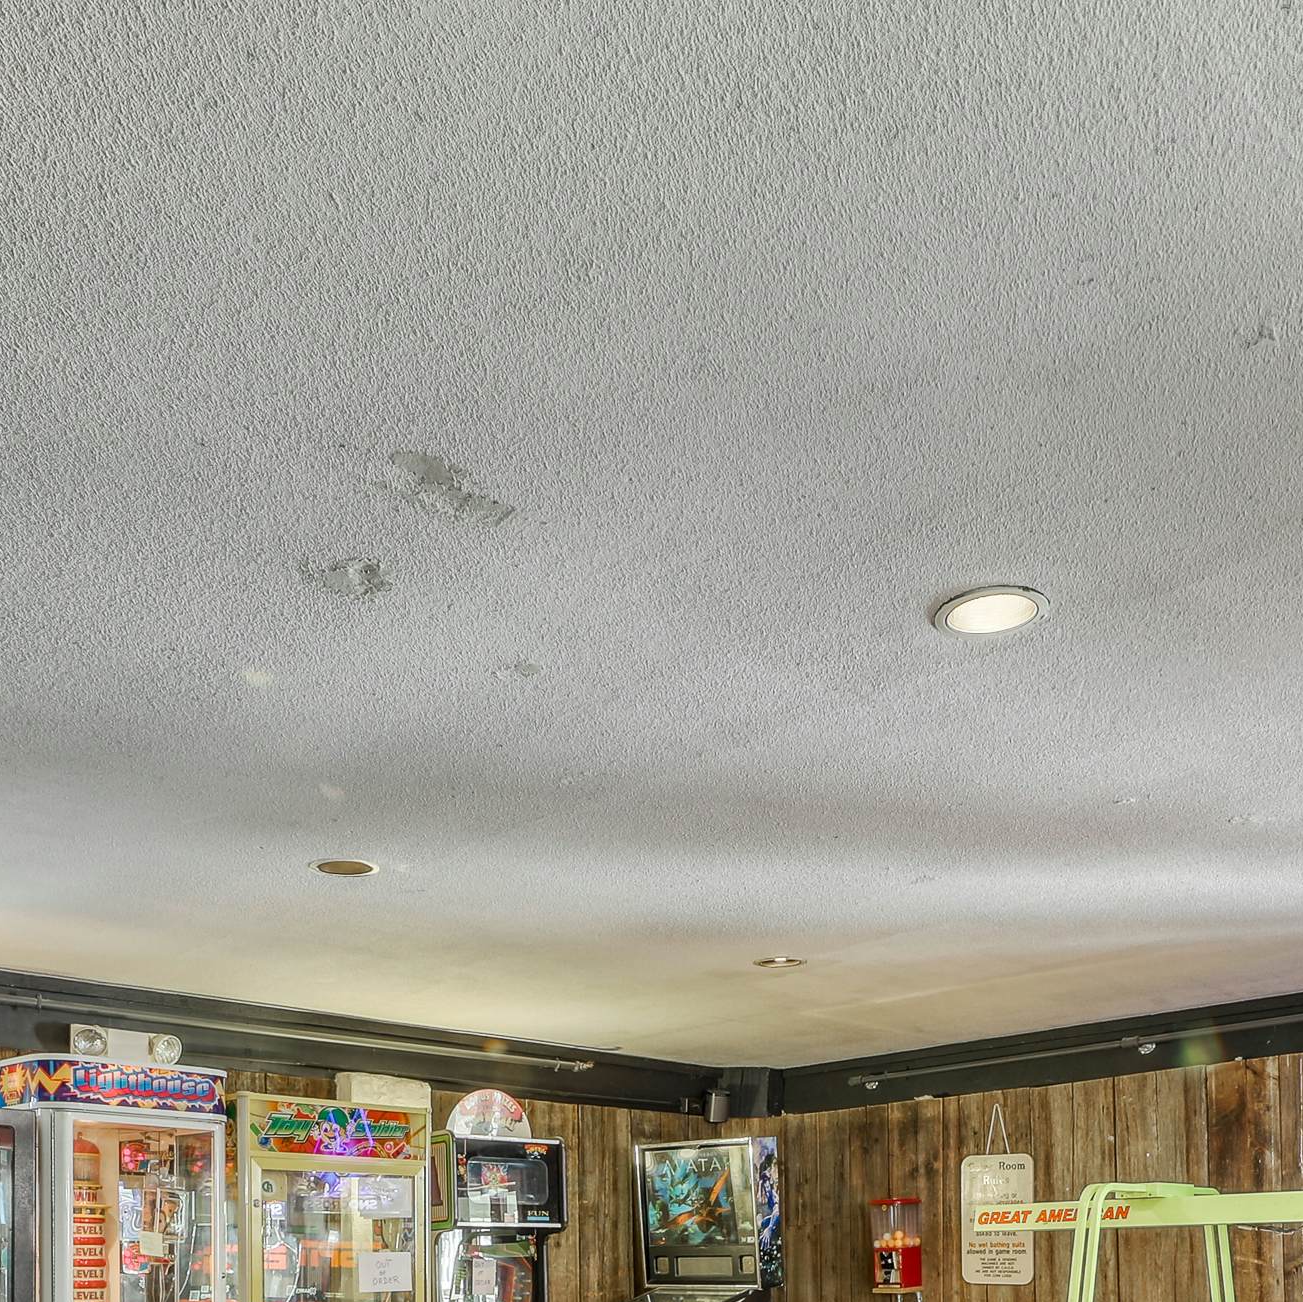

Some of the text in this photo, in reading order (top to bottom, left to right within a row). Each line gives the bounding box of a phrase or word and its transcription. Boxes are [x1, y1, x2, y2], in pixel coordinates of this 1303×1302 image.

[74, 1067, 211, 1097] Lighthouse
[265, 1113, 409, 1142] Toy Soldier
[999, 1161, 1026, 1171] Room
[977, 1205, 1130, 1225] GREAT AMEAN
